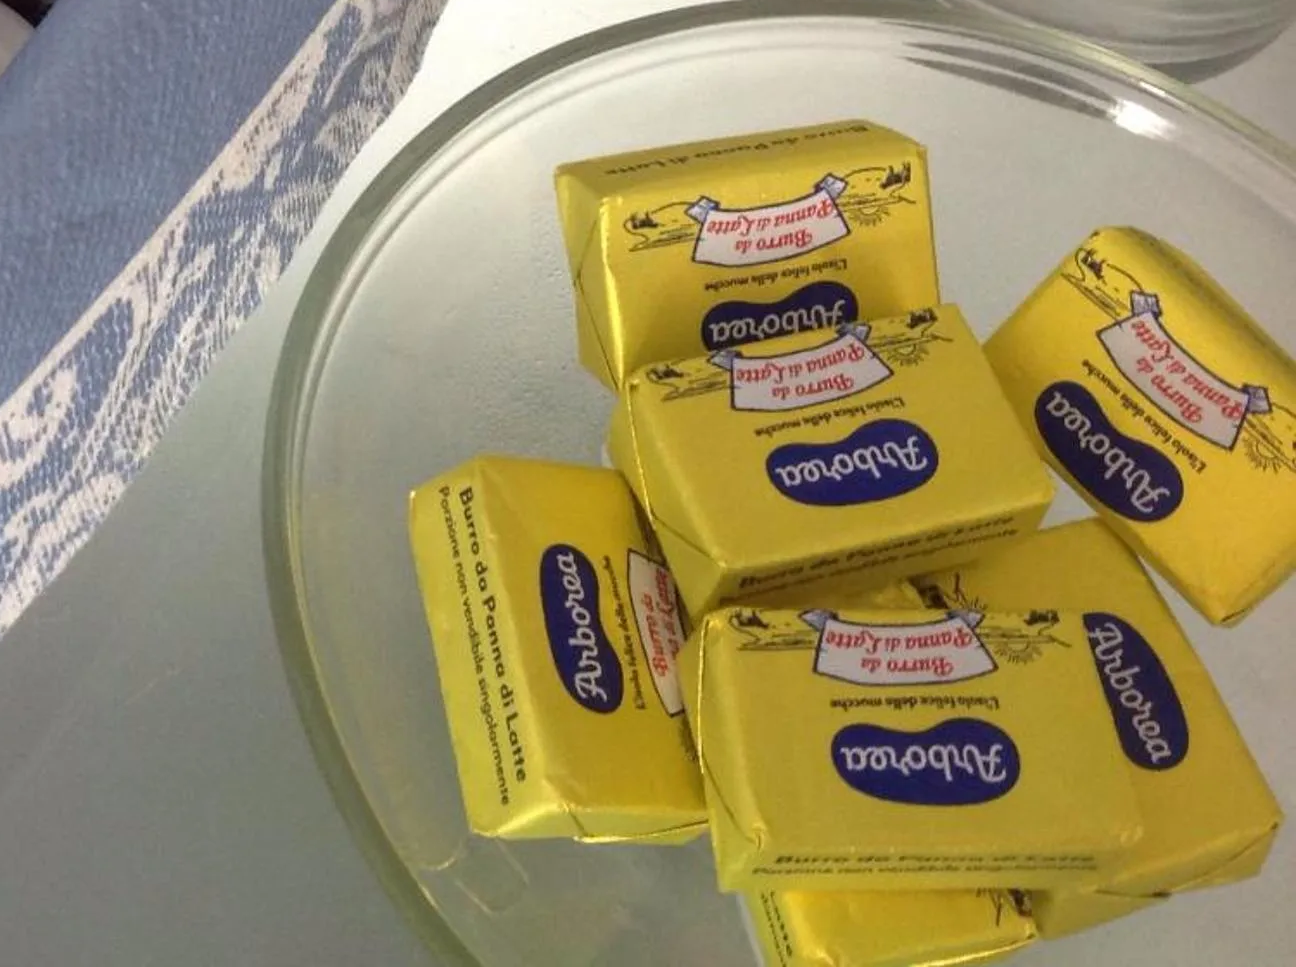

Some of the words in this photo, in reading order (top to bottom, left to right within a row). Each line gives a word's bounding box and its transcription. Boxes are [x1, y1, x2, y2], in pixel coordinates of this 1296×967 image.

[705, 214, 757, 242] Latte
[754, 216, 772, 232] di
[773, 196, 837, 230] Panna
[734, 236, 753, 255] da
[753, 228, 814, 252] Burro
[708, 298, 846, 343] Arborea
[803, 342, 866, 374] Panna
[1131, 319, 1175, 364] Latte
[735, 362, 789, 385] Latte
[787, 362, 803, 378] di
[1135, 356, 1154, 375] da
[1165, 354, 1186, 375] di
[771, 384, 792, 400] da
[795, 373, 854, 396] Burro
[1151, 375, 1203, 424] Burro
[1183, 365, 1243, 421] Panna
[775, 435, 929, 487] Arborea
[1046, 391, 1171, 513] Arborea
[438, 485, 461, 560] Porzione
[459, 485, 481, 557] Burro
[455, 562, 468, 596] non
[474, 558, 489, 593] da
[461, 596, 484, 675] vendibile
[482, 596, 506, 679] Panna
[556, 551, 608, 703] Arborea
[825, 628, 883, 656] Latte
[884, 636, 902, 652] di
[904, 627, 973, 650] Panna
[646, 614, 670, 678] Burro
[860, 657, 882, 674] da
[886, 656, 955, 677] Burro
[500, 682, 514, 709] di
[1088, 621, 1172, 765] Arborea
[478, 677, 510, 807] singolarmente
[506, 711, 527, 783] Latte
[840, 743, 1008, 784] Arborea
